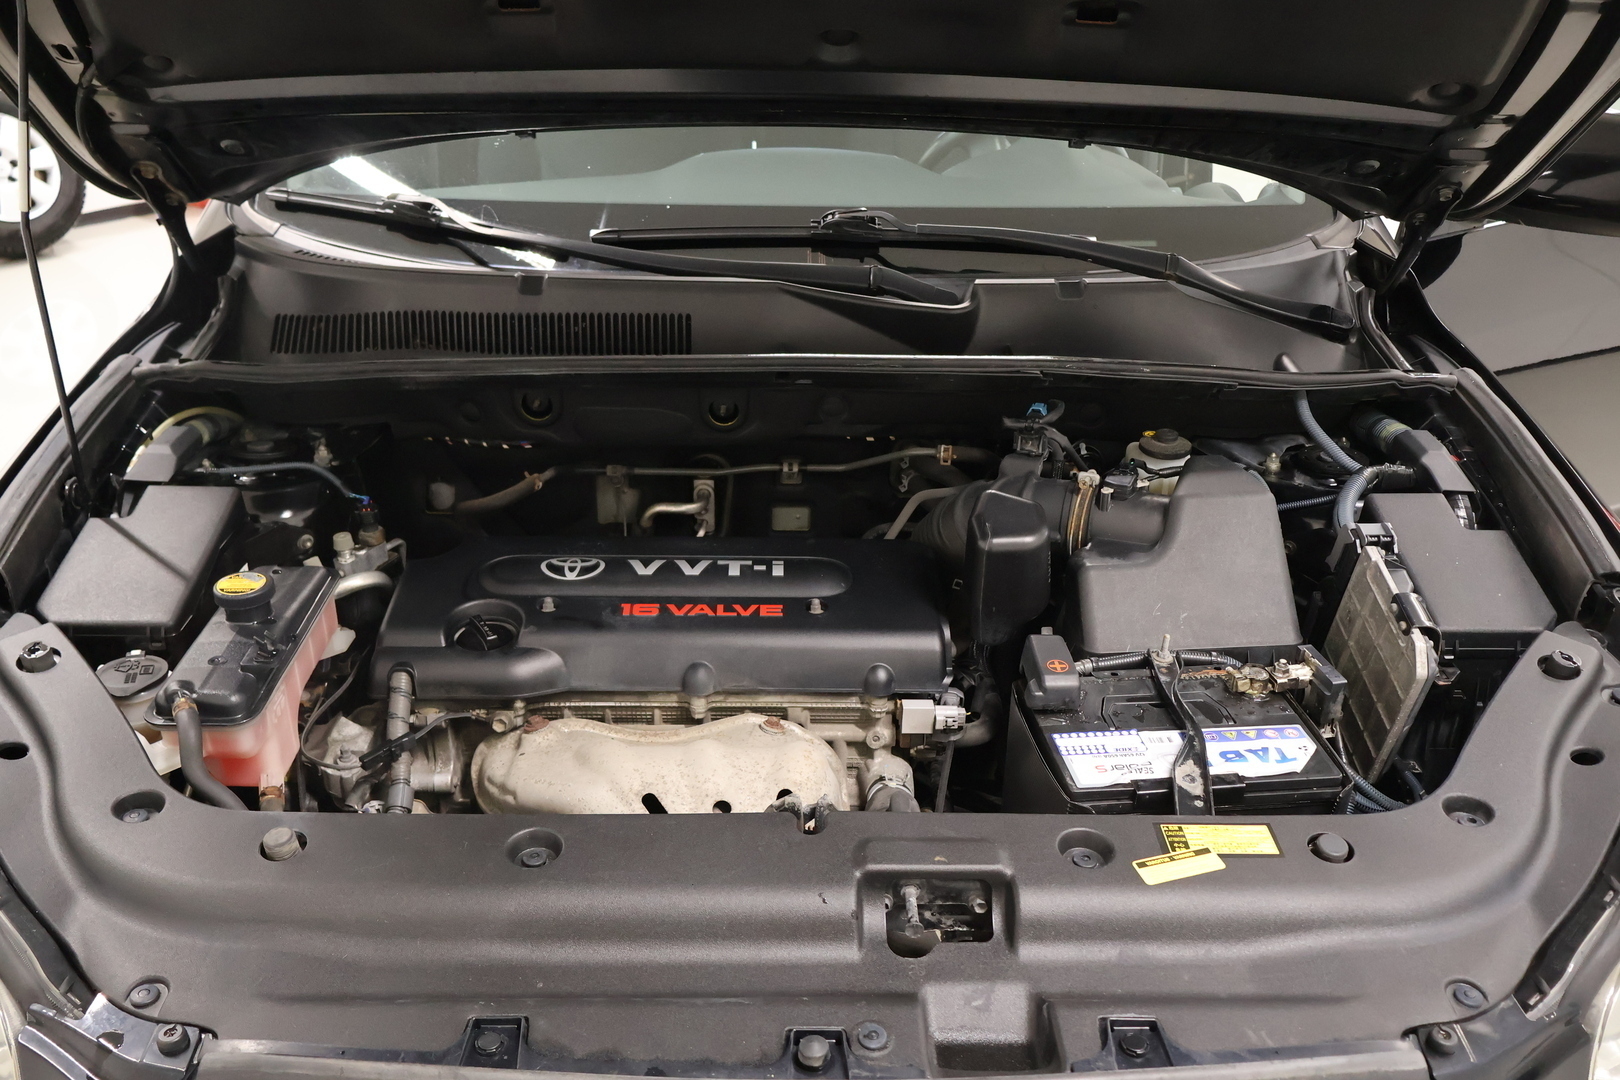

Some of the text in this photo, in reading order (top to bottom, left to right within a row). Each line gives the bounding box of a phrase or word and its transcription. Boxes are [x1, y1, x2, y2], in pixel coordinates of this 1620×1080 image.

[627, 559, 785, 577] VVT-i
[620, 603, 785, 617] 16 VALVE
[1218, 746, 1298, 764] TAB
